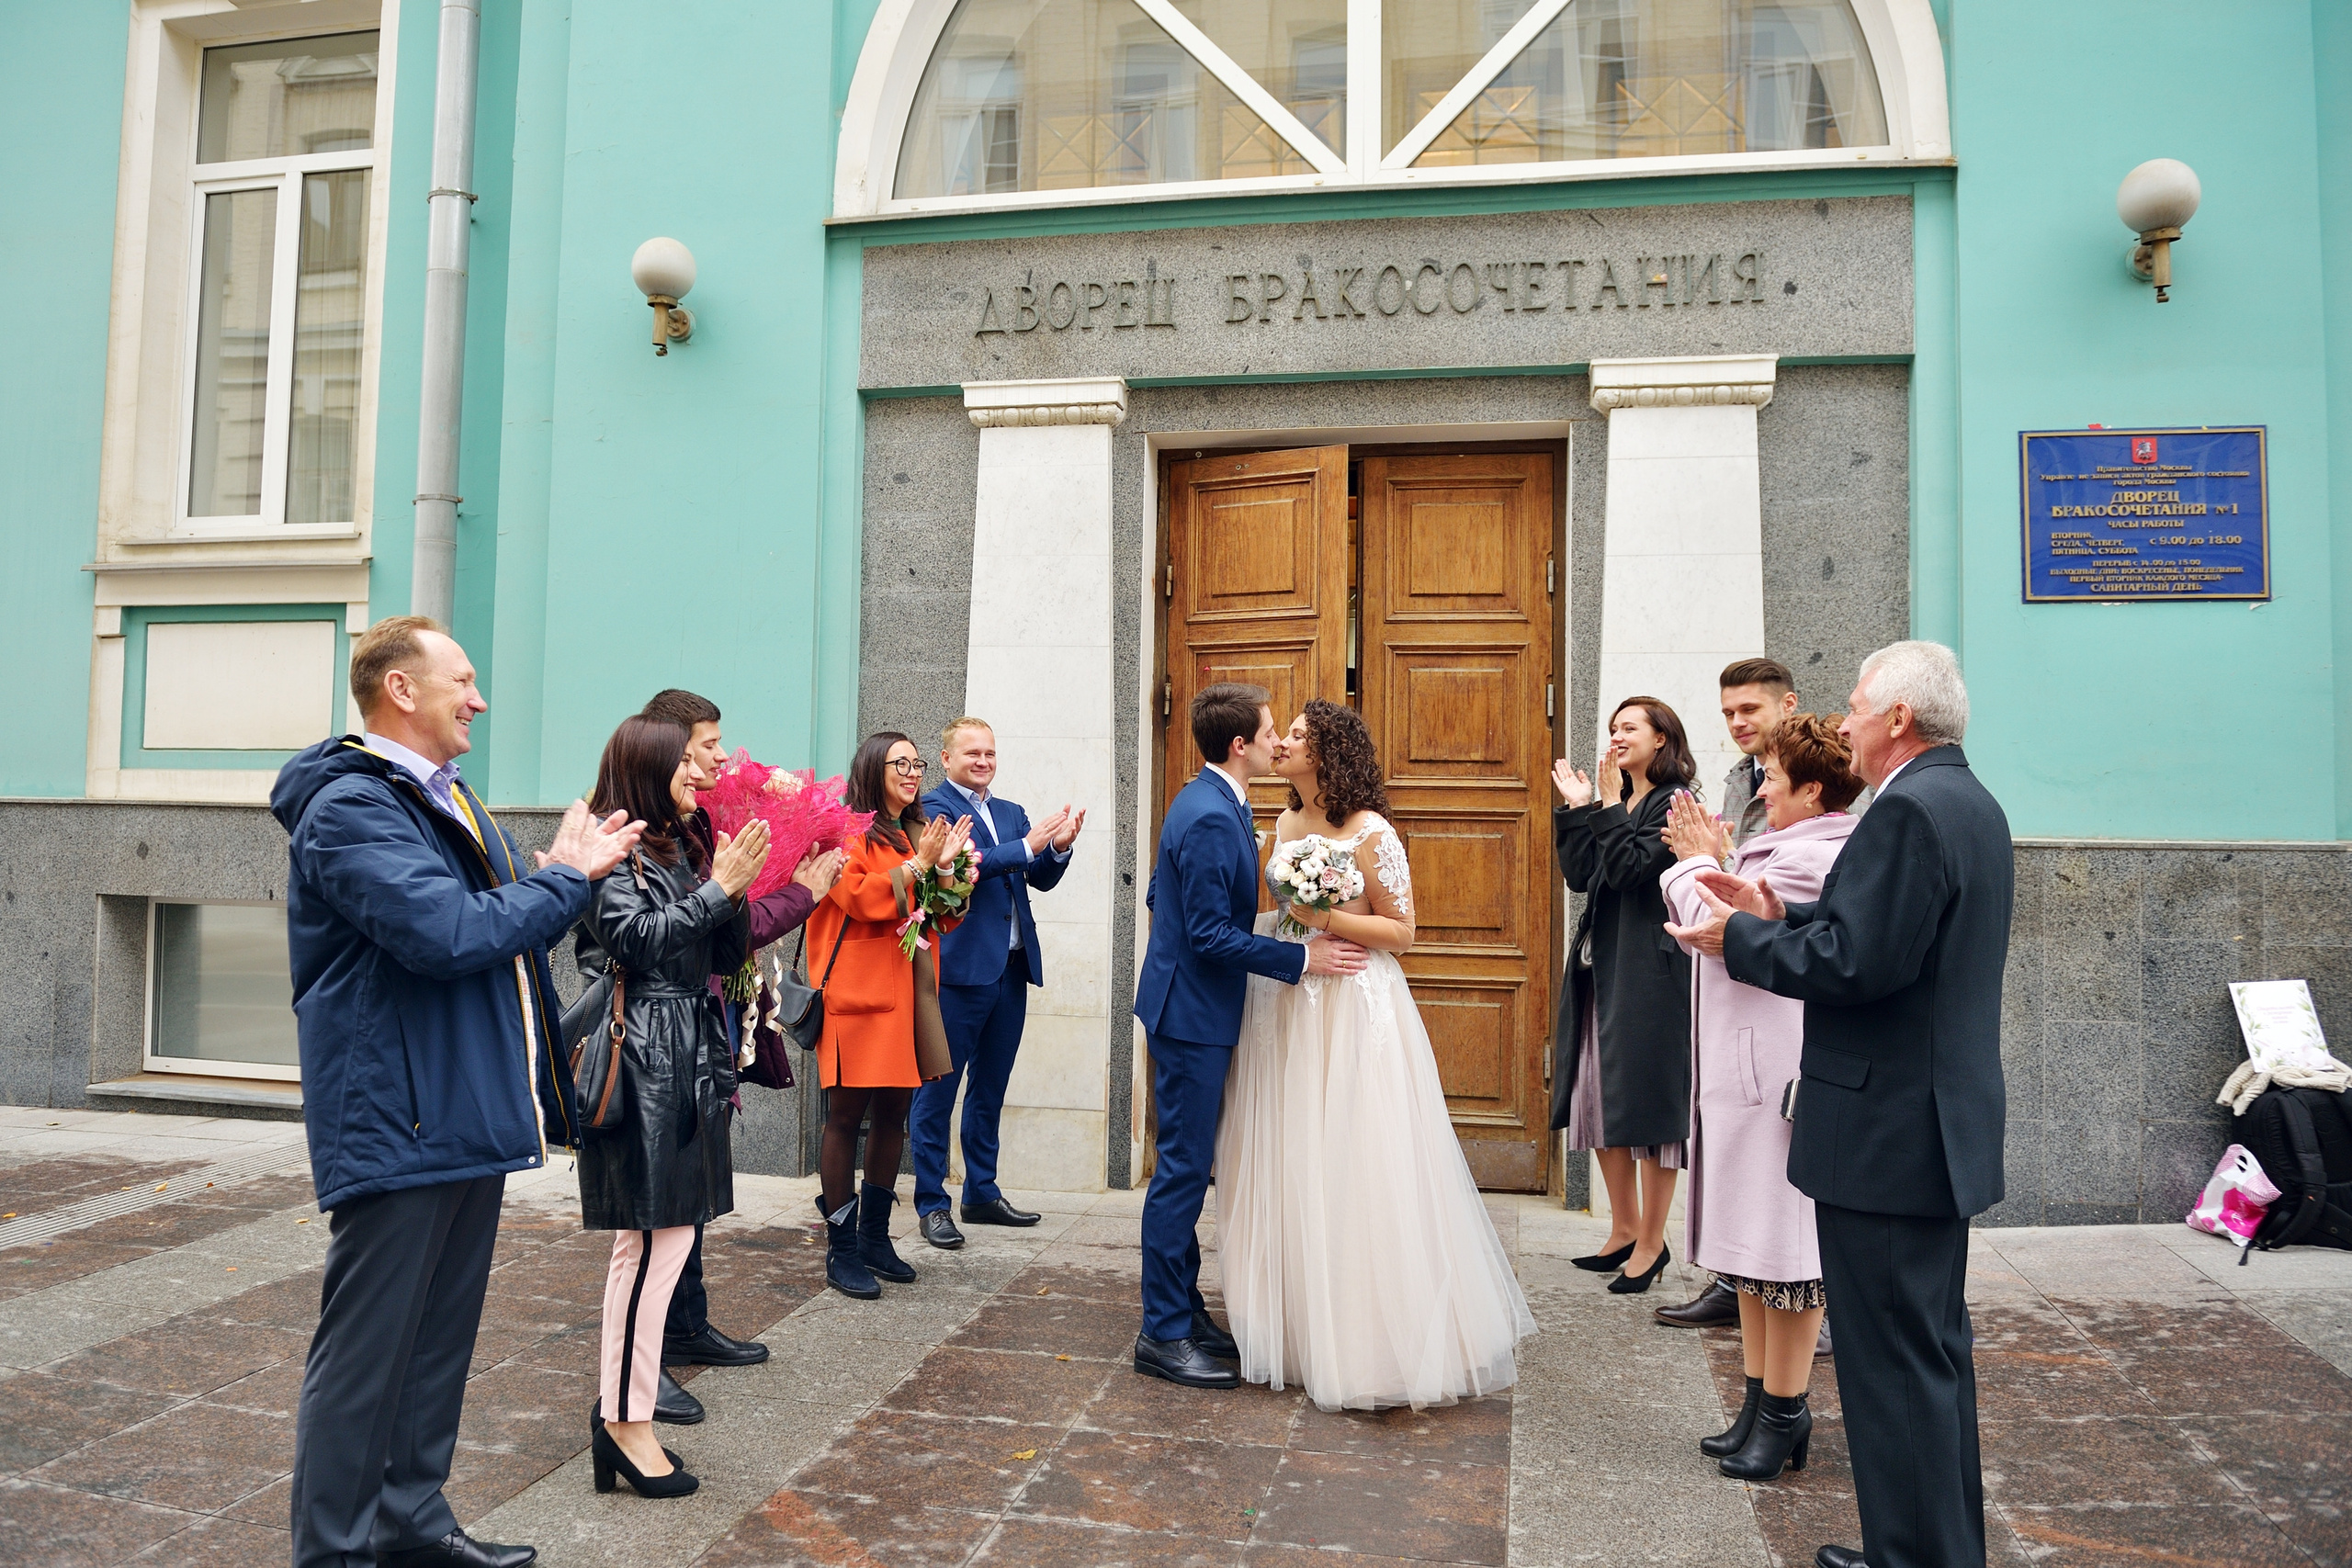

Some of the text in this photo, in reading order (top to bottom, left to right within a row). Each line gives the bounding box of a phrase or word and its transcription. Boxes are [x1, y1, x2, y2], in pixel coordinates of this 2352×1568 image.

[974, 251, 1765, 337] ДВОРЕЦ БРАКОСОЧЕТАНИЯ
[2110, 491, 2180, 504] ДВОРЕЦ
[2052, 503, 2207, 517] БРАКОСОЧЕТАНИЯ
[2108, 519, 2185, 528] ЧАСЫ РАБОТЫ
[2159, 536, 2187, 546] 9.00
[2188, 536, 2204, 547] до
[2208, 535, 2243, 545] 18.00
[2098, 547, 2139, 555] СУББОТА
[2069, 574, 2104, 582] ПЕРВЫЙ
[2106, 574, 2143, 582] ВТОРНИК
[2145, 573, 2187, 581] КАЖДОГО
[2090, 581, 2203, 592] САНИТАРНЫЙ ДЕНЬ
